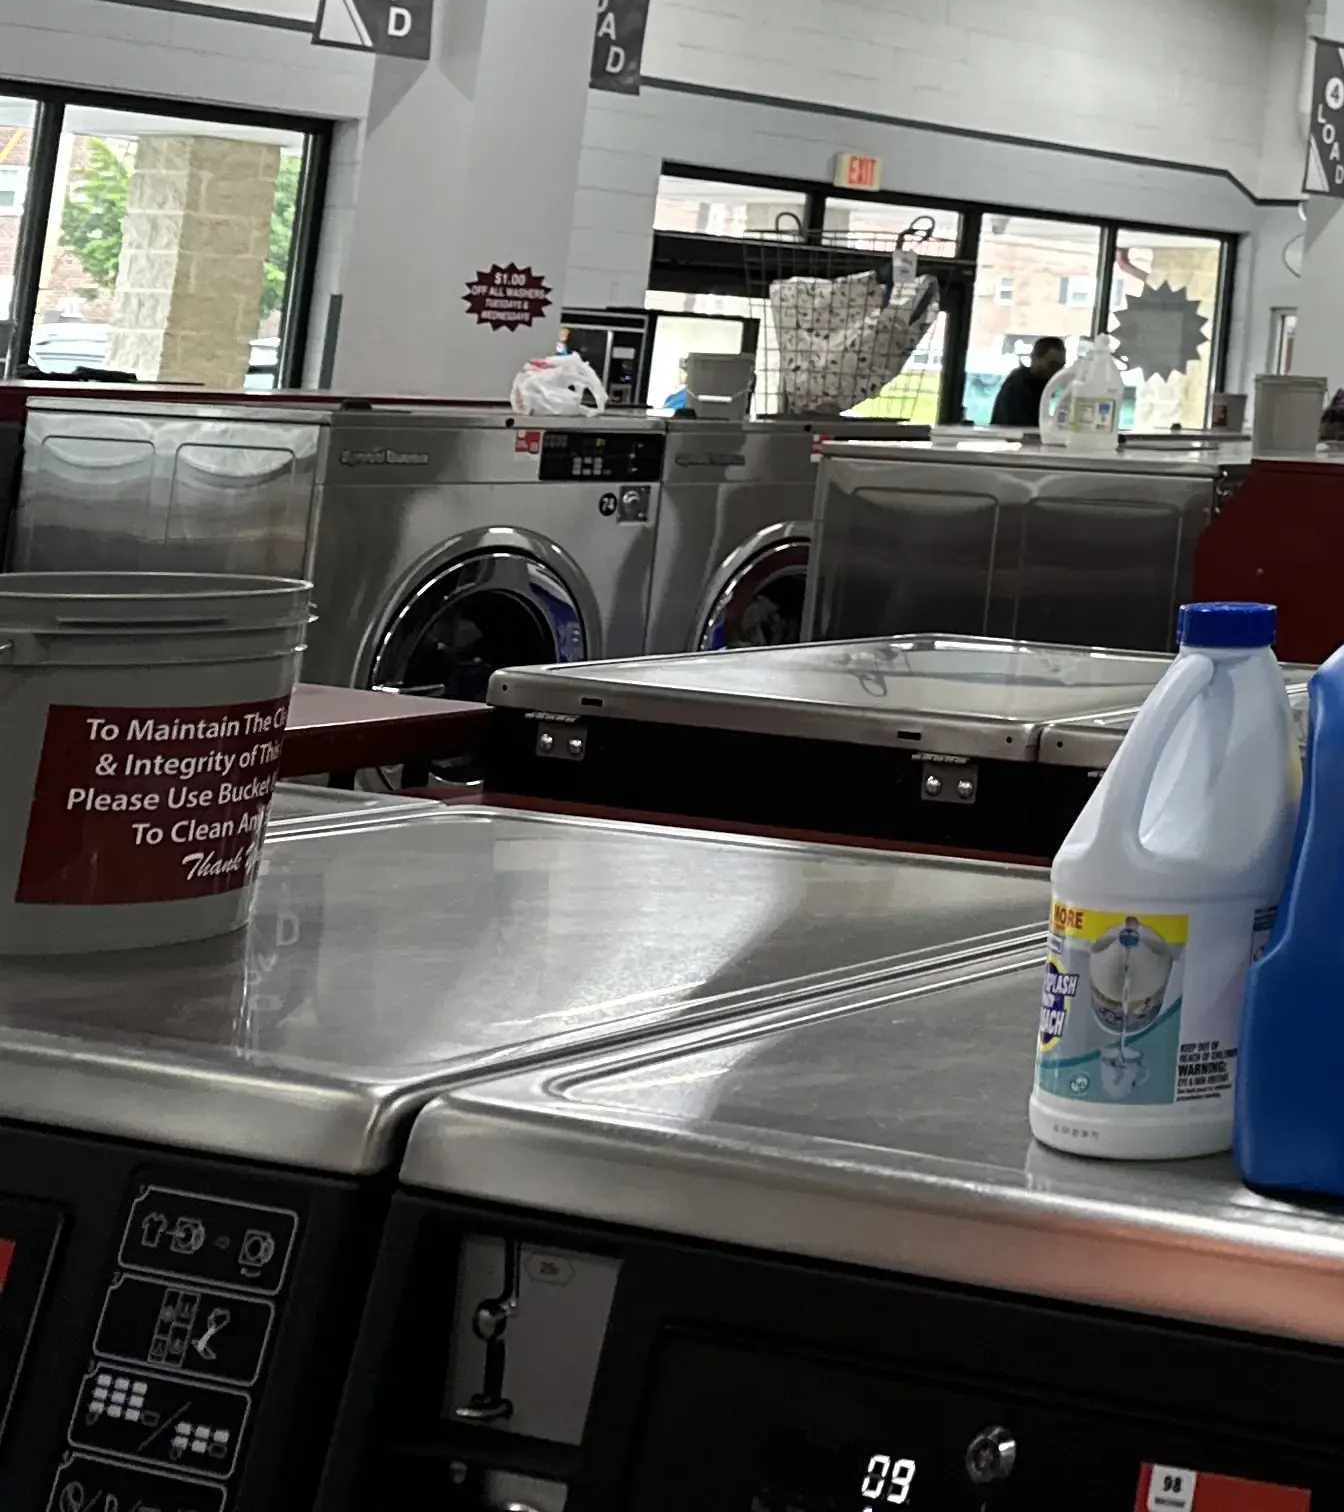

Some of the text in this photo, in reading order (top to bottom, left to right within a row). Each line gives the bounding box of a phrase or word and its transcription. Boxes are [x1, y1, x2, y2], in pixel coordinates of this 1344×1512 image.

[494, 272, 526, 286] $1.00
[87, 718, 120, 741] To
[127, 715, 240, 741] Maintain
[243, 712, 271, 736] The
[94, 753, 118, 777] &
[124, 749, 237, 780] Integrity
[239, 749, 258, 769] of
[66, 787, 160, 812] Please
[167, 786, 213, 809] Use
[218, 775, 272, 805] Bucket
[132, 823, 163, 846] To
[170, 818, 234, 843] Clean
[181, 845, 244, 881] Thank
[861, 1453, 916, 1505] 09
